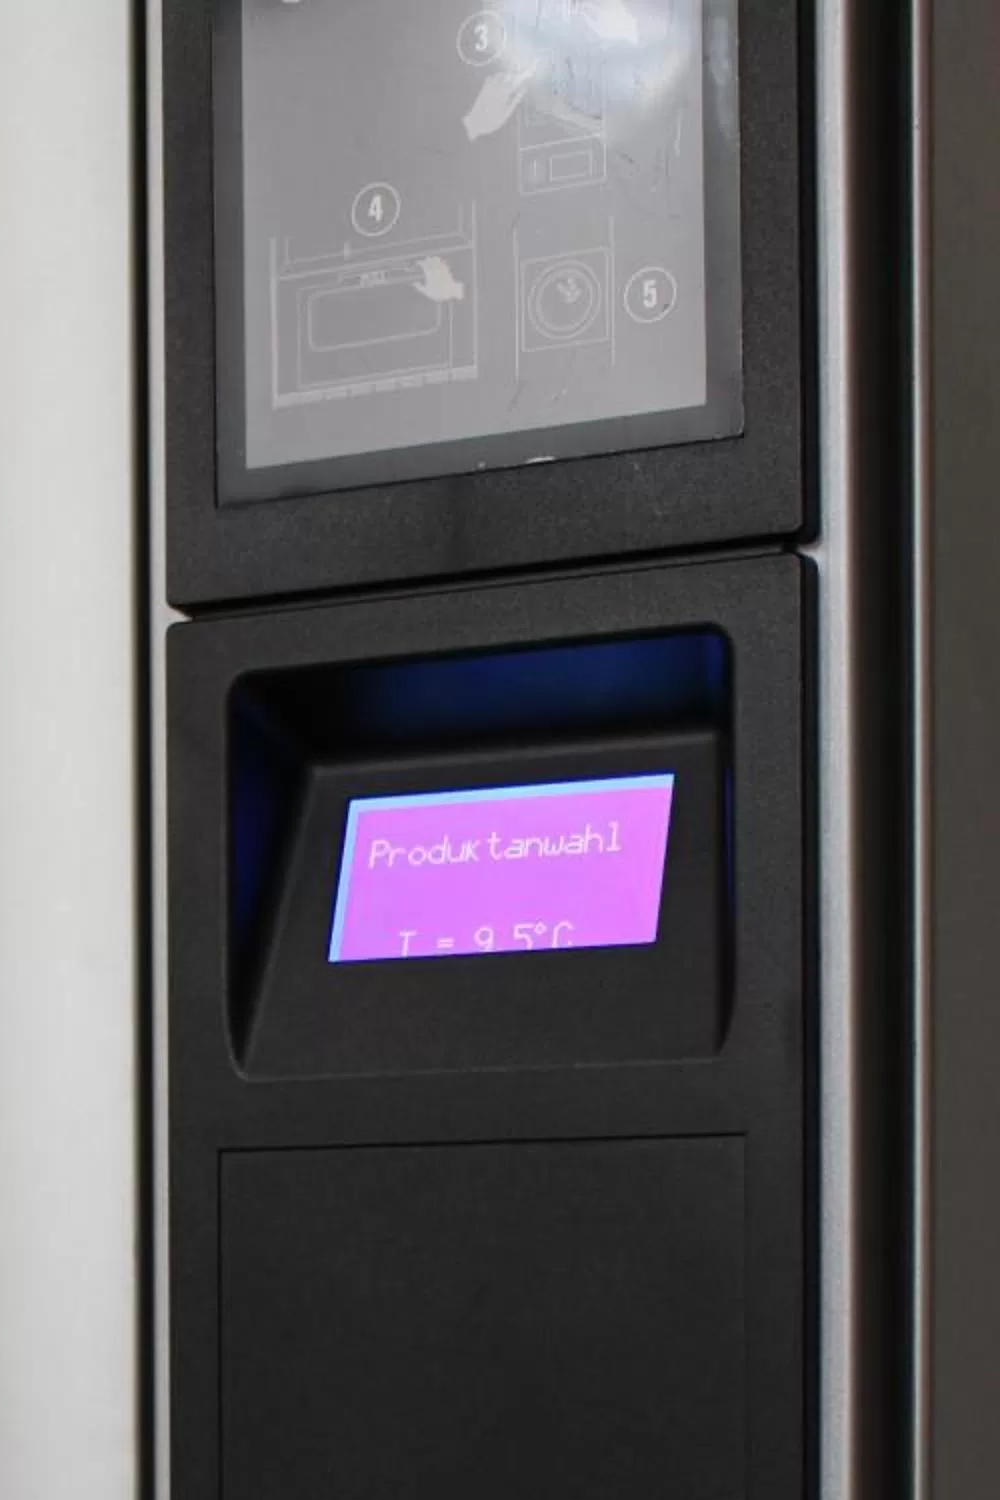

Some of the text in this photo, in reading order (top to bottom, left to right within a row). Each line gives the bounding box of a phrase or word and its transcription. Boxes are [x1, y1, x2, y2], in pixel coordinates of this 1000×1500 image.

[474, 23, 488, 51] 3
[367, 194, 384, 222] 4
[643, 278, 657, 308] 5
[368, 820, 624, 869] Produktanwahl
